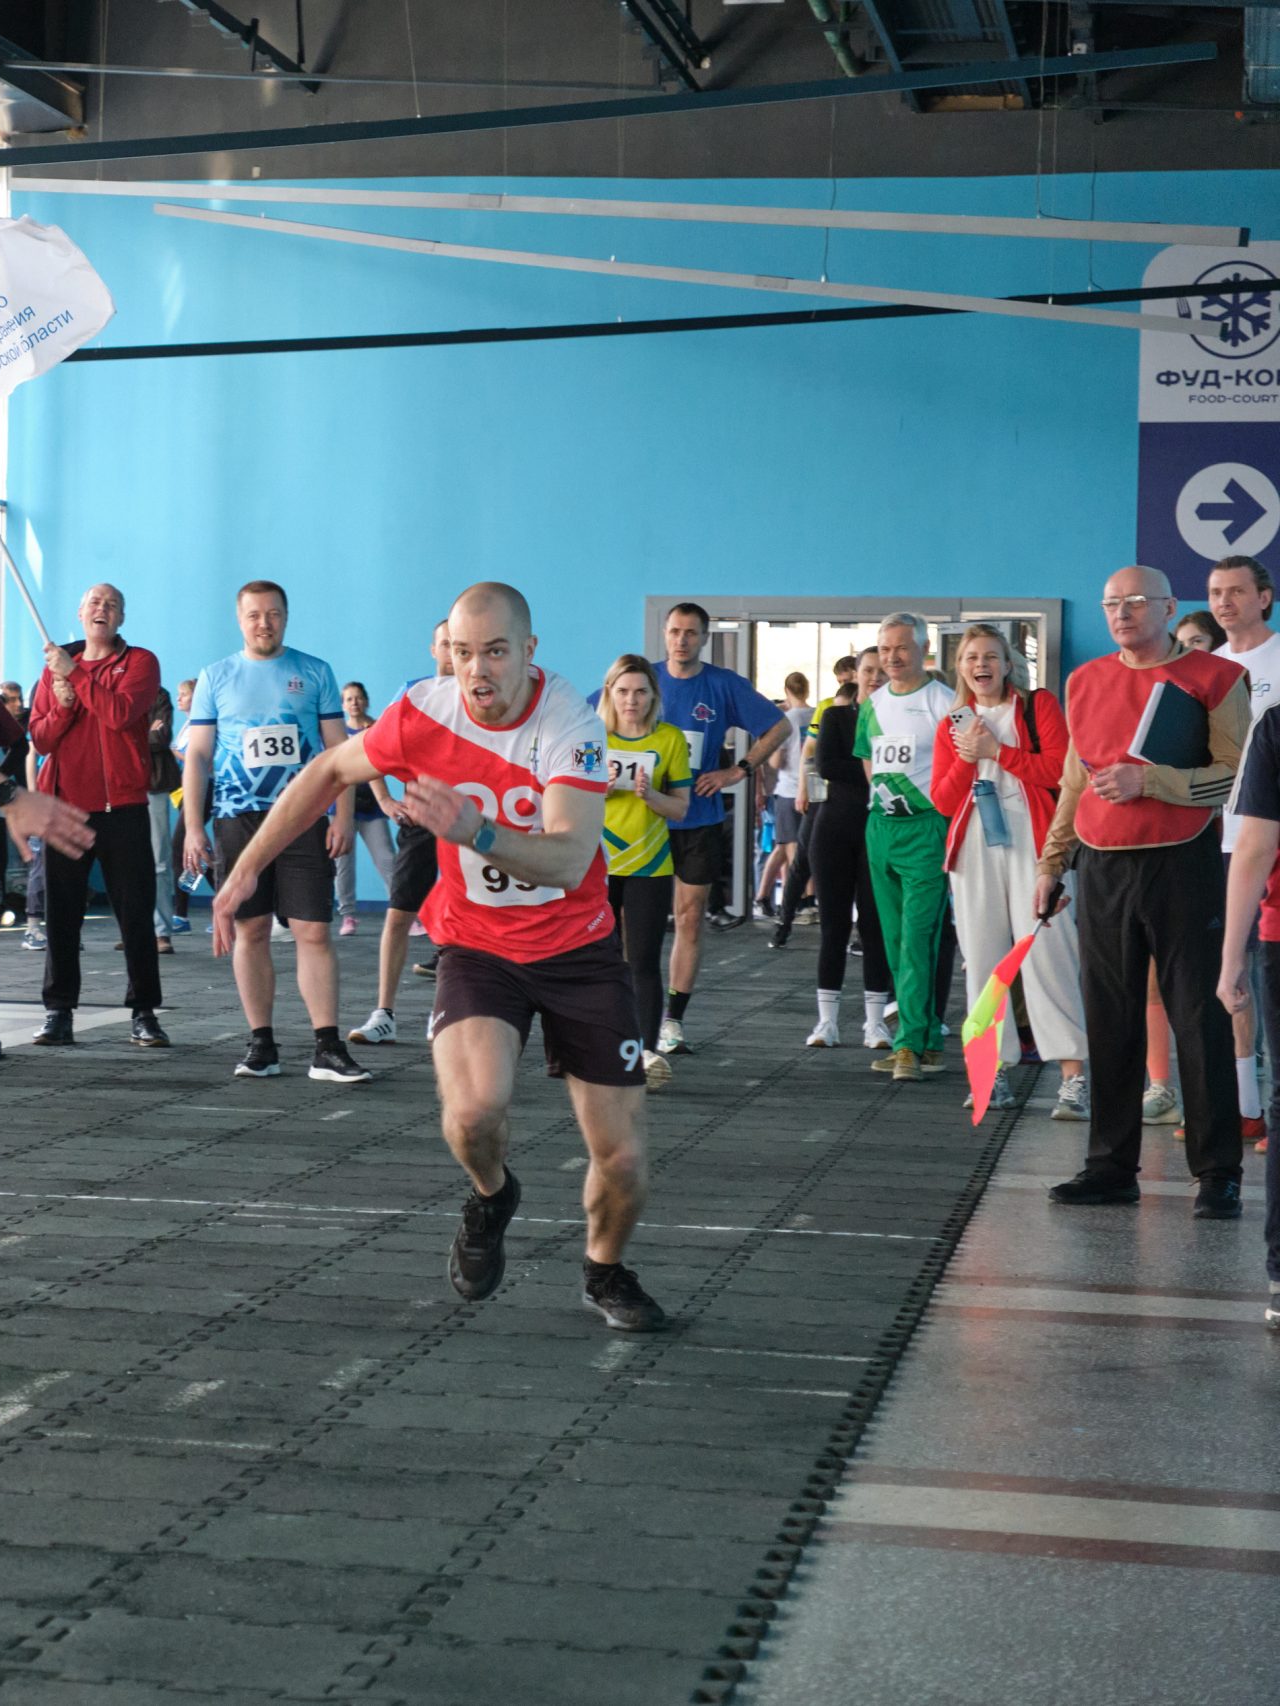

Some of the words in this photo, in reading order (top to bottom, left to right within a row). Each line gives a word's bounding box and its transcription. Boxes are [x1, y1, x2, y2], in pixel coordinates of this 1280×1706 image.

[1156, 369, 1280, 389] ФУД-КО
[1188, 394, 1279, 404] FOOD-COURT
[248, 736, 295, 758] 138
[875, 745, 912, 764] 108
[482, 865, 538, 893] 9
